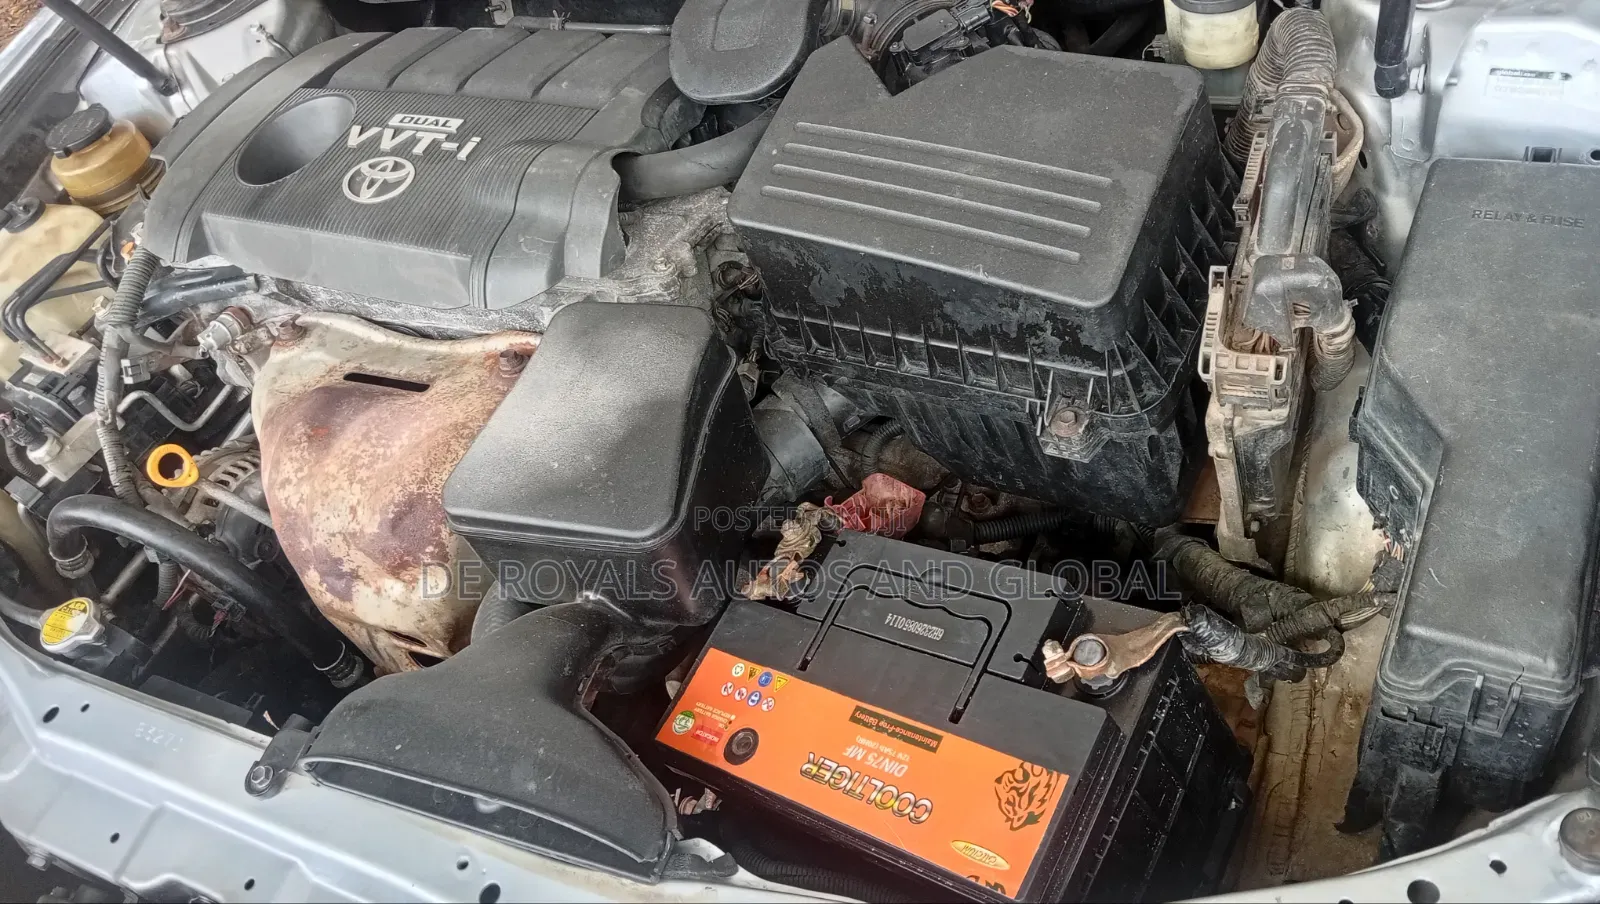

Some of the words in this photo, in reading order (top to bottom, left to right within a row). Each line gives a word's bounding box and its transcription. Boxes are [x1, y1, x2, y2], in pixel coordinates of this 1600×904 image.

[399, 115, 452, 128] DUAL
[347, 124, 481, 161] VVT-i
[1471, 209, 1522, 222] RELAY
[1526, 213, 1537, 224] &
[1541, 214, 1585, 229] FUSE
[853, 710, 878, 727] Battery
[695, 729, 720, 743] INDICATOR
[878, 718, 939, 748] Maintenance-Free
[842, 744, 867, 761] MF
[864, 752, 909, 778] DIN75
[800, 751, 934, 825] COOLTIGER
[960, 844, 997, 865] CALCIUM
